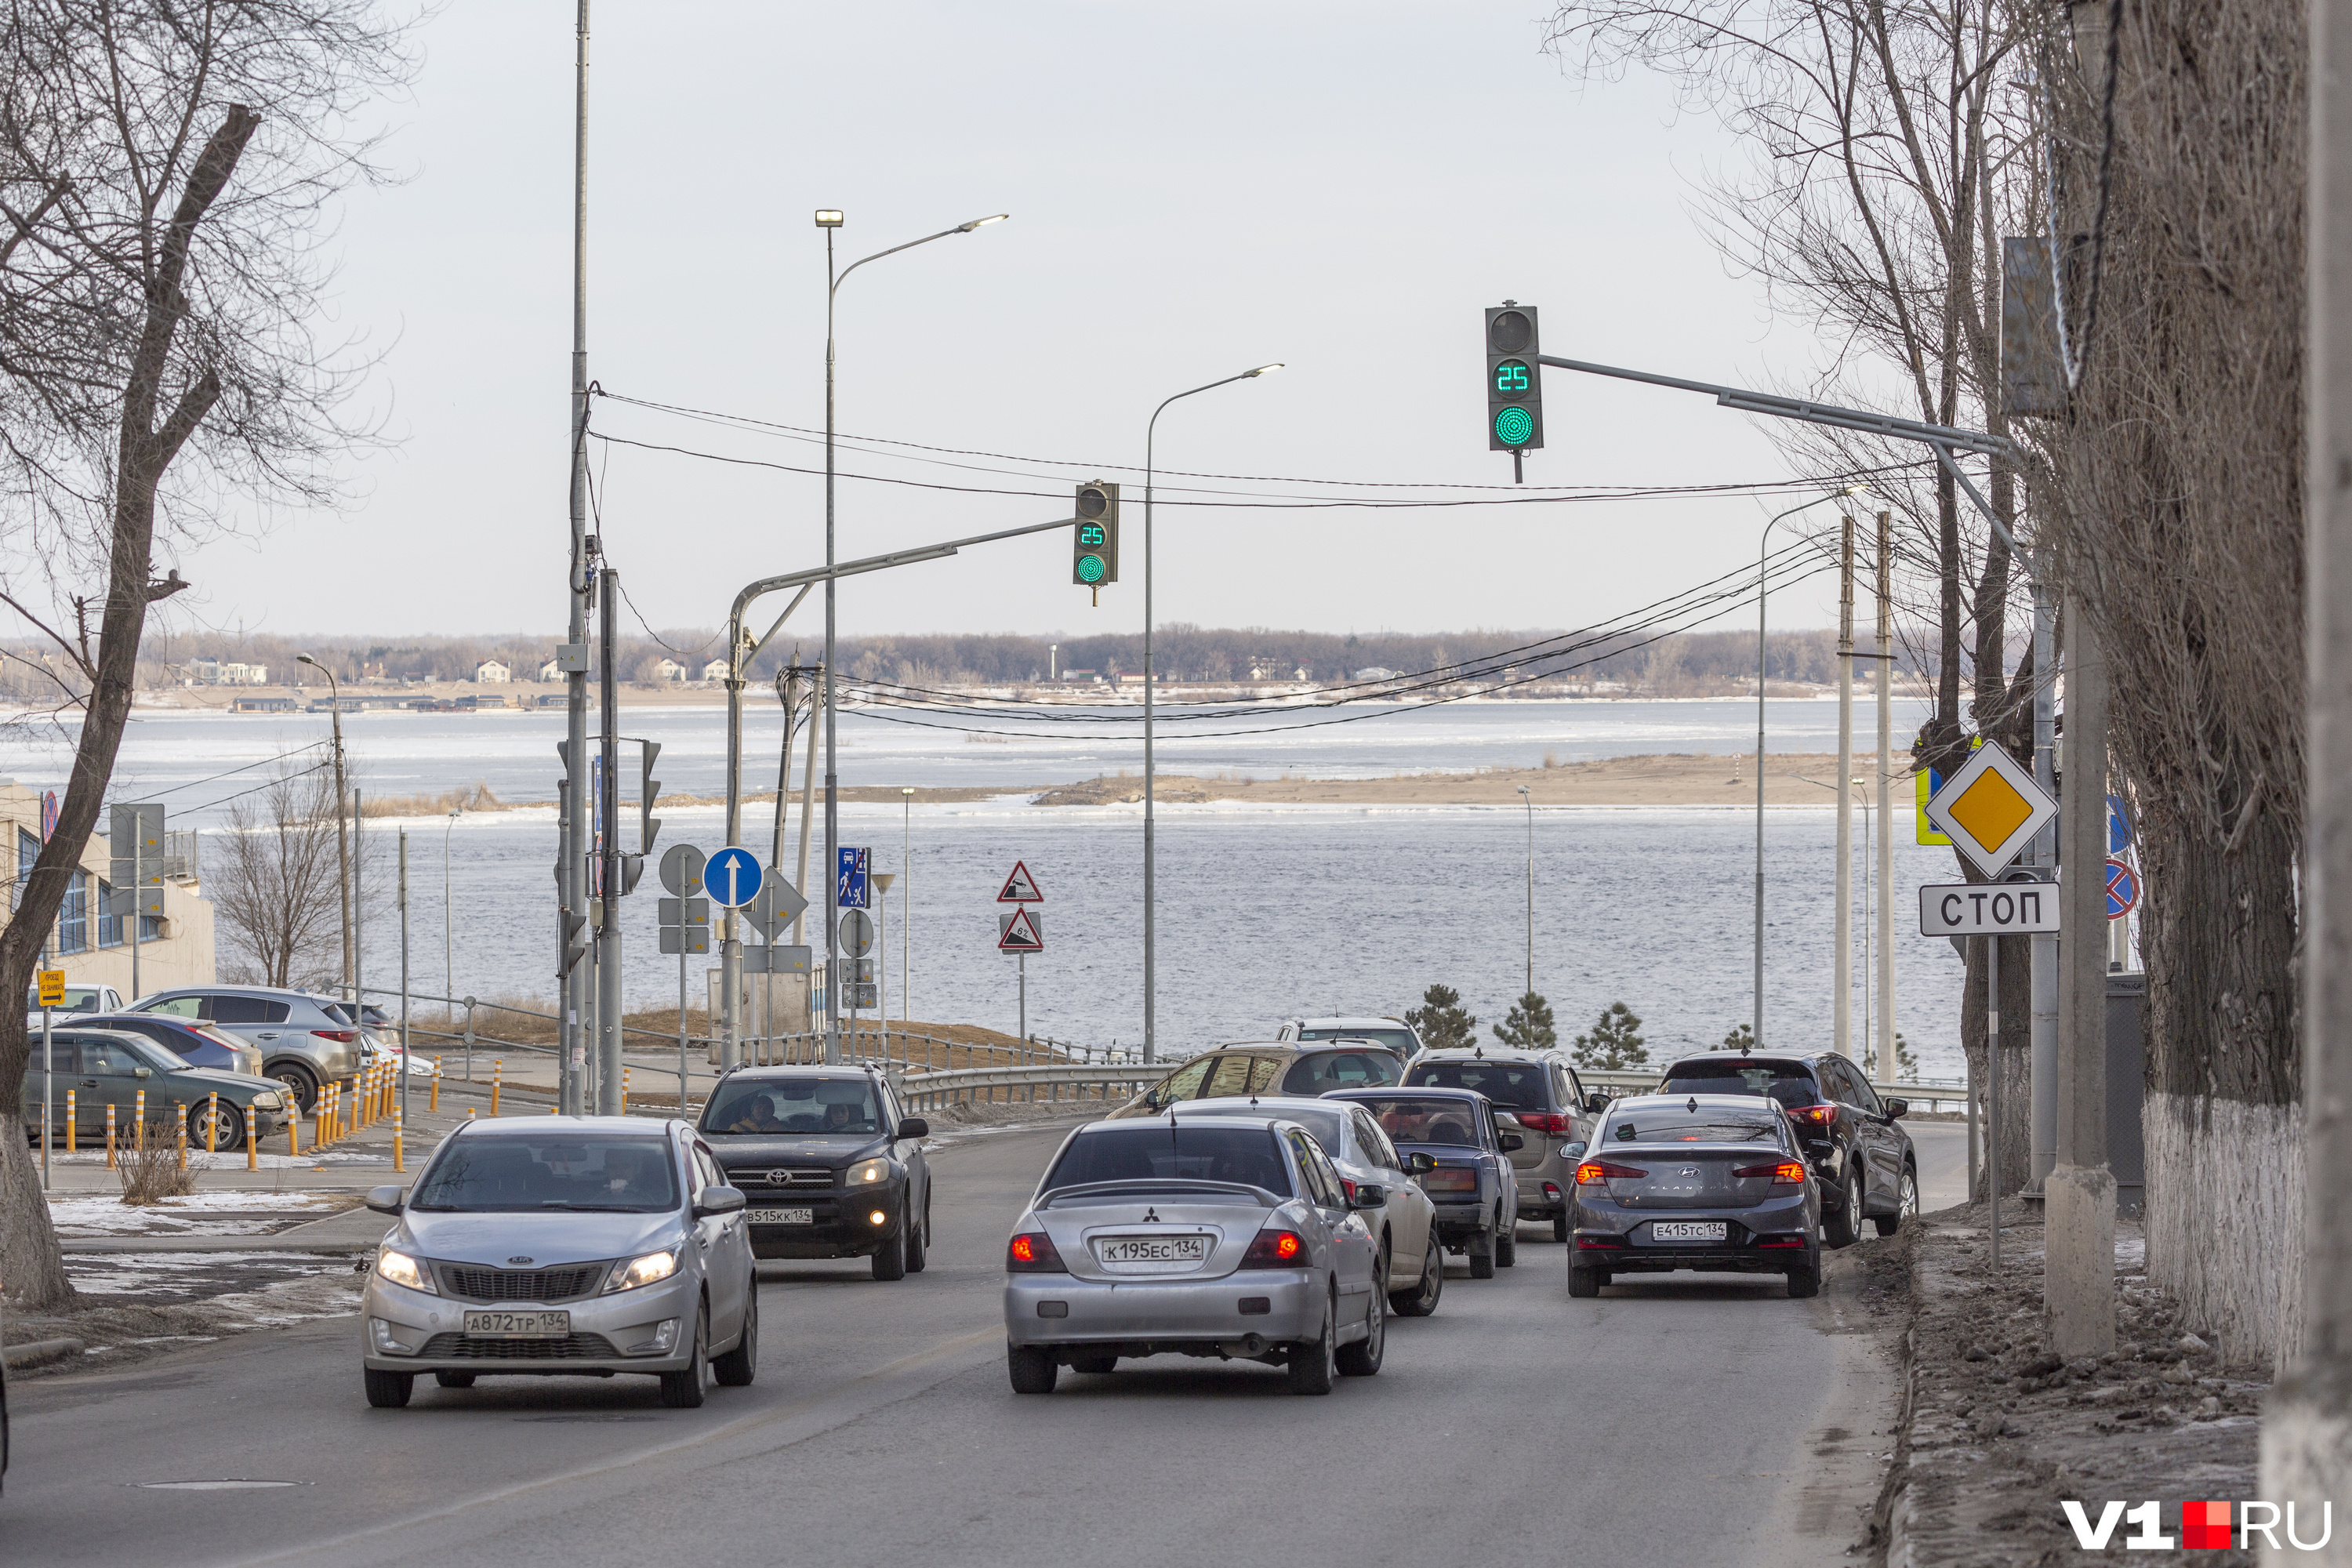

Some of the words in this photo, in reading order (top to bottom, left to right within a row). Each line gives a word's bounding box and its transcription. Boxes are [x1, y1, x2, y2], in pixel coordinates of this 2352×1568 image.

[1498, 366, 1528, 390] 25
[1081, 527, 1103, 544] 25
[1941, 891, 2041, 926] СТОП
[1017, 927, 1029, 938] 6%
[747, 1210, 791, 1222] В515КК
[793, 1210, 810, 1218] 134
[1657, 1224, 1703, 1236] Е415ТС
[1706, 1223, 1723, 1232] 134
[1108, 1243, 1171, 1259] К195ЕС
[1174, 1240, 1198, 1253] 134
[470, 1314, 535, 1331] А872ТР
[539, 1313, 564, 1326] 134
